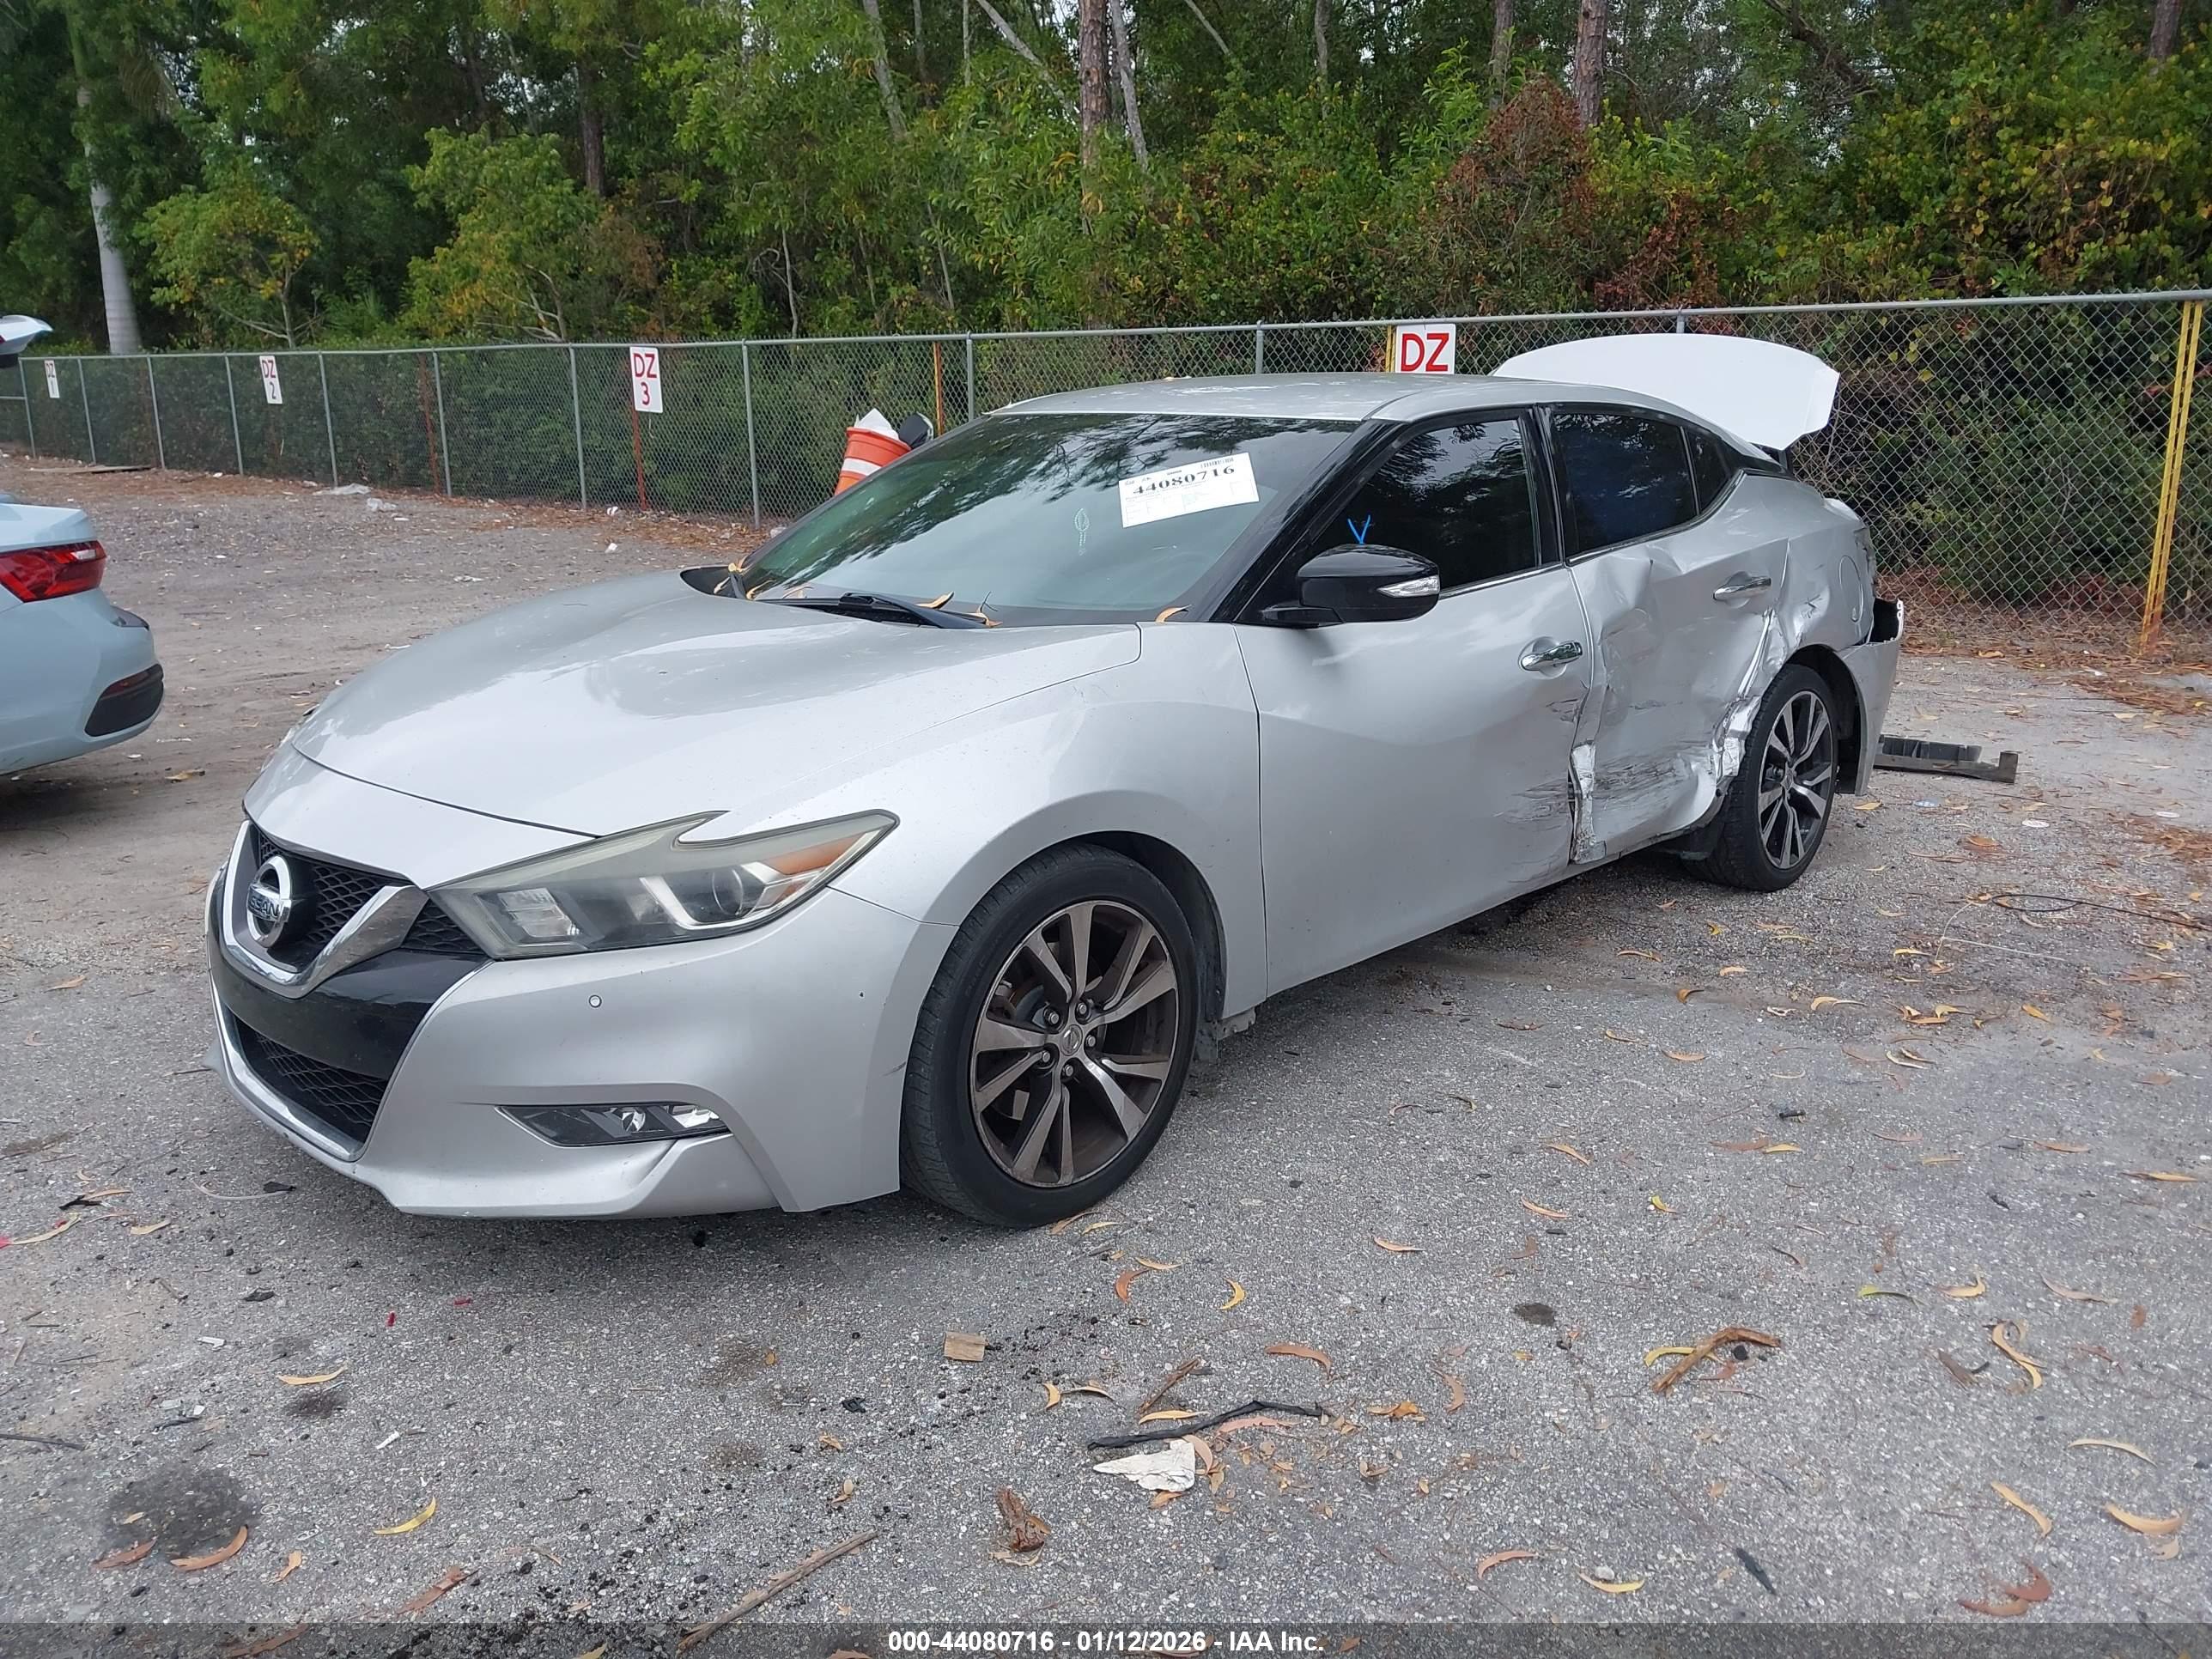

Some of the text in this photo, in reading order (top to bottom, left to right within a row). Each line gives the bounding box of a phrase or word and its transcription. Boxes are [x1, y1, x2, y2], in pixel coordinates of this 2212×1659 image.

[1401, 332, 1449, 372] DZ
[261, 359, 276, 379] DZ
[633, 352, 658, 379] DZ
[269, 381, 277, 400] 2
[641, 381, 650, 406] 3
[1133, 465, 1235, 495] 44080716
